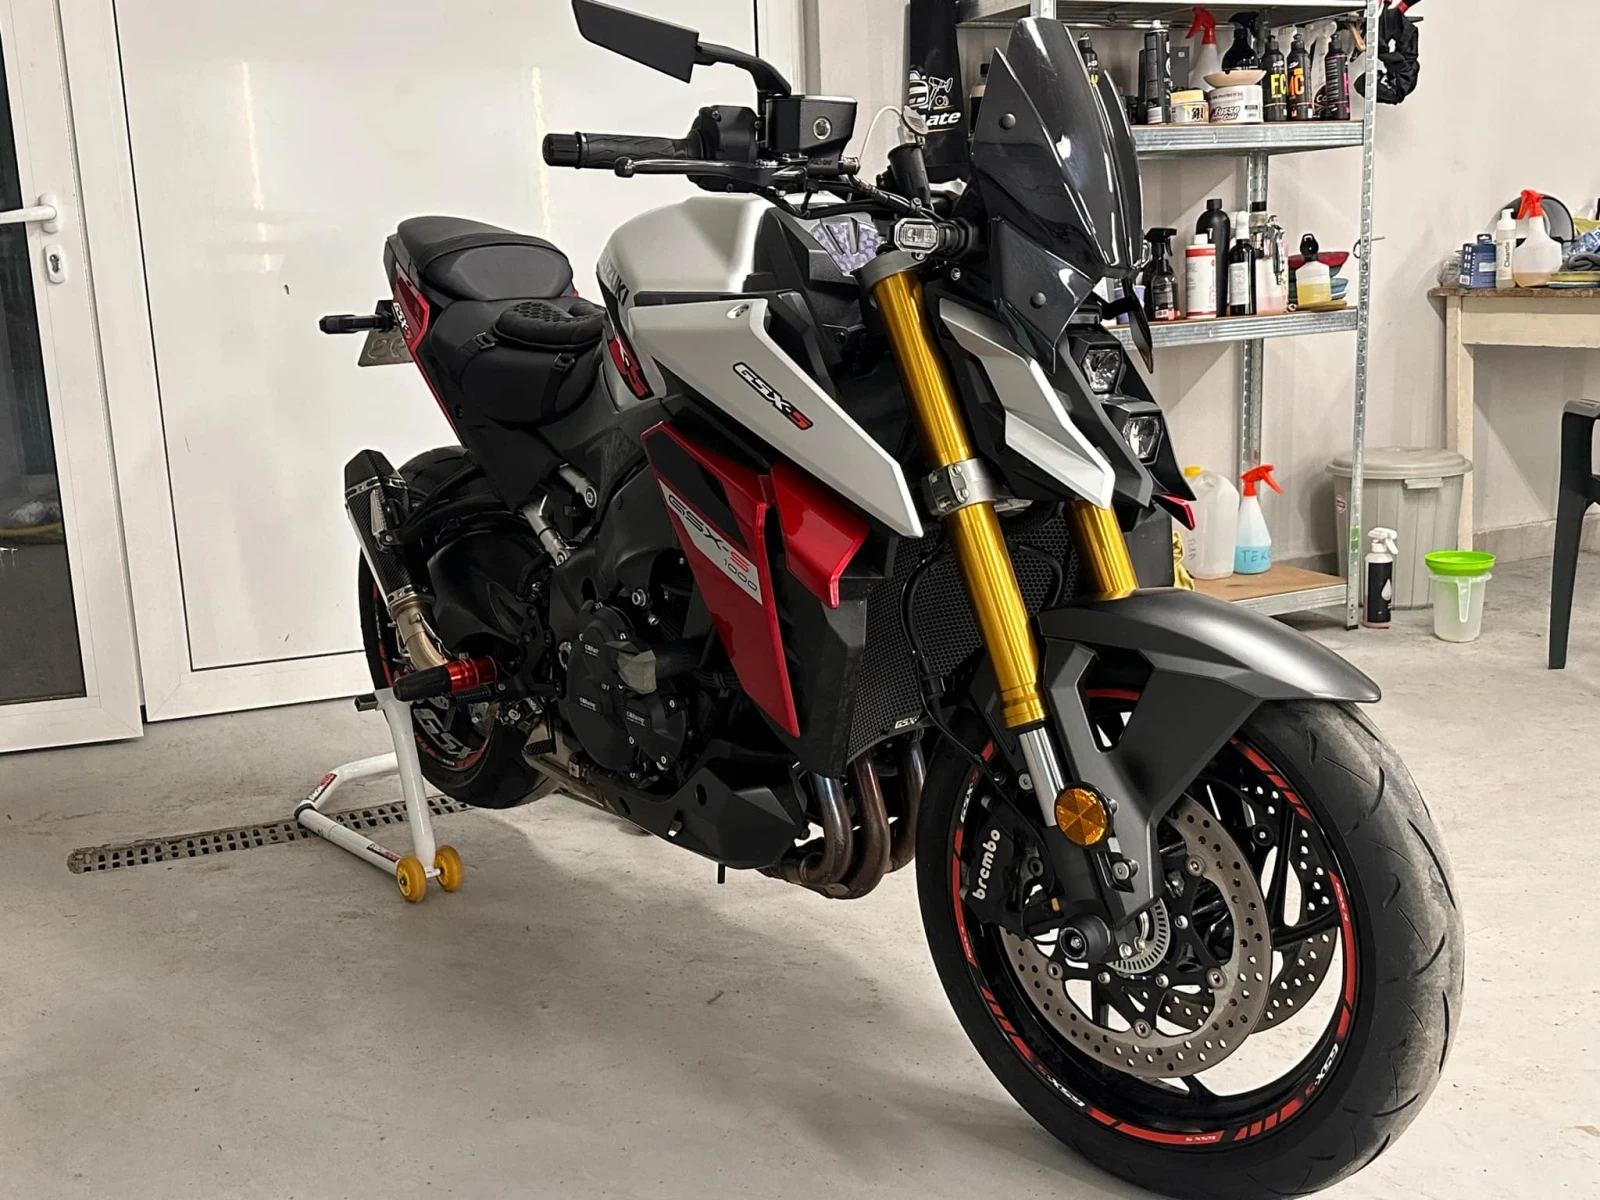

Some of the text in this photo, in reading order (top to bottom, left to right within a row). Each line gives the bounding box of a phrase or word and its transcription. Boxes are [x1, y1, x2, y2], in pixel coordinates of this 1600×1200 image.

[602, 255, 630, 307] UZUKI
[732, 361, 814, 430] GSX-S
[668, 494, 751, 573] GSX-S
[723, 558, 758, 592] 1000
[971, 828, 1002, 901] brembo
